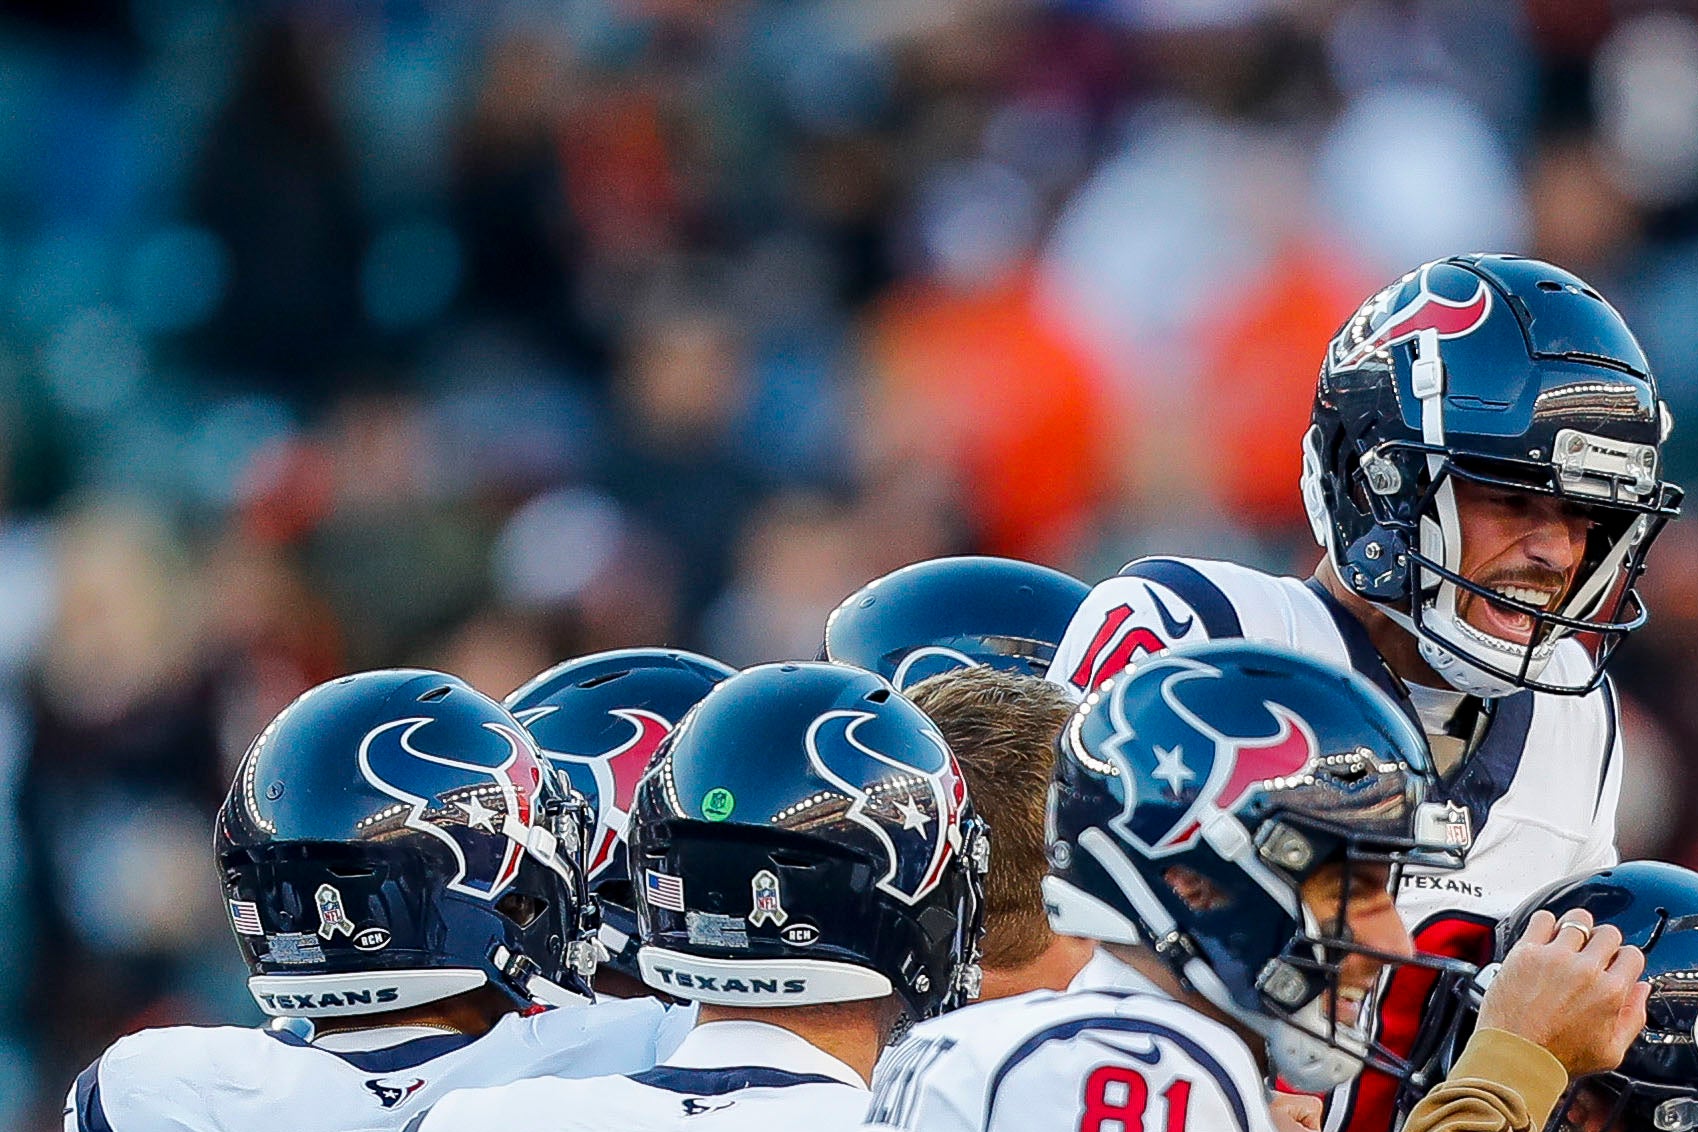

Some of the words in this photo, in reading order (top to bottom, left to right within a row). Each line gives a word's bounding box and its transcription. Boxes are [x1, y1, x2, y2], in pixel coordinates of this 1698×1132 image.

[1401, 874, 1484, 898] TEXANS
[653, 966, 808, 994] TEXANS
[259, 986, 400, 1011] TEXANS
